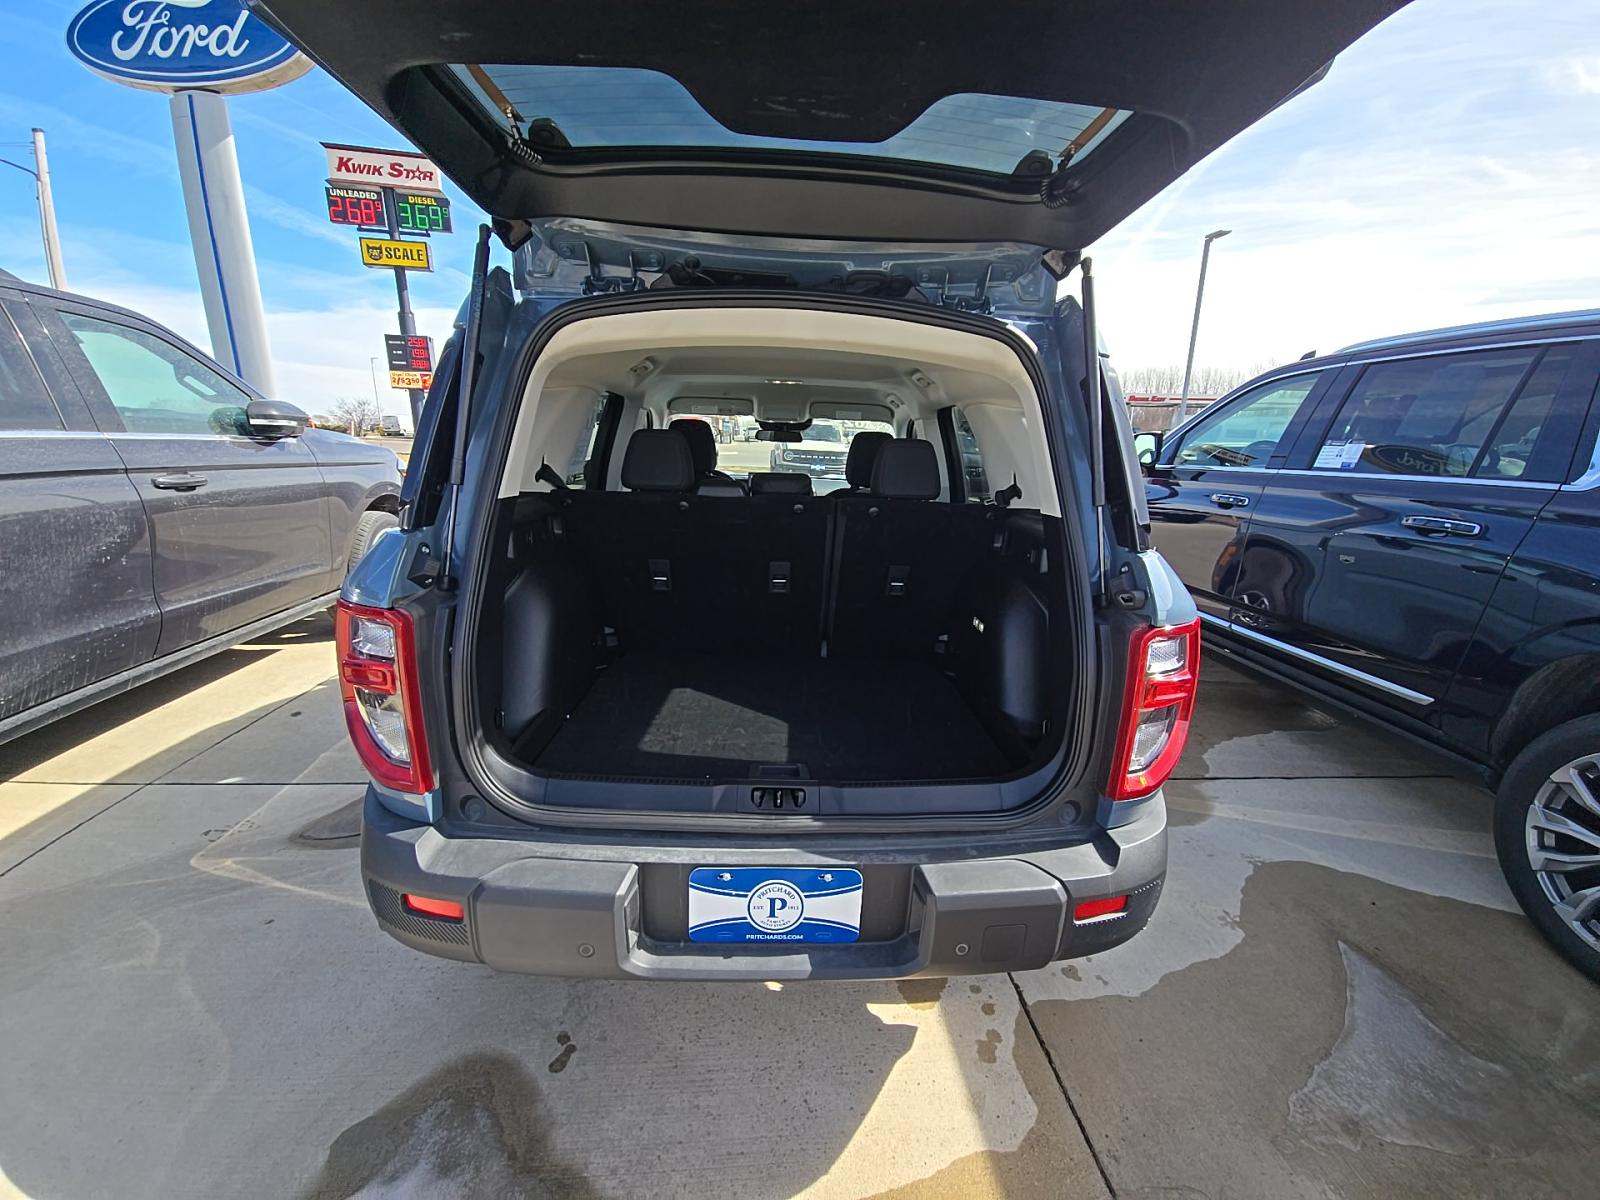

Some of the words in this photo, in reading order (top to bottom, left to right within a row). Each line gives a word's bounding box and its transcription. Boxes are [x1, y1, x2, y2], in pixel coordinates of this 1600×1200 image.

[112, 0, 249, 60] Ford
[329, 188, 378, 200] UNLEADED
[409, 195, 437, 206] DIESEL
[385, 246, 424, 262] SCALE
[756, 886, 796, 900] PRITCHARD
[766, 897, 788, 919] P
